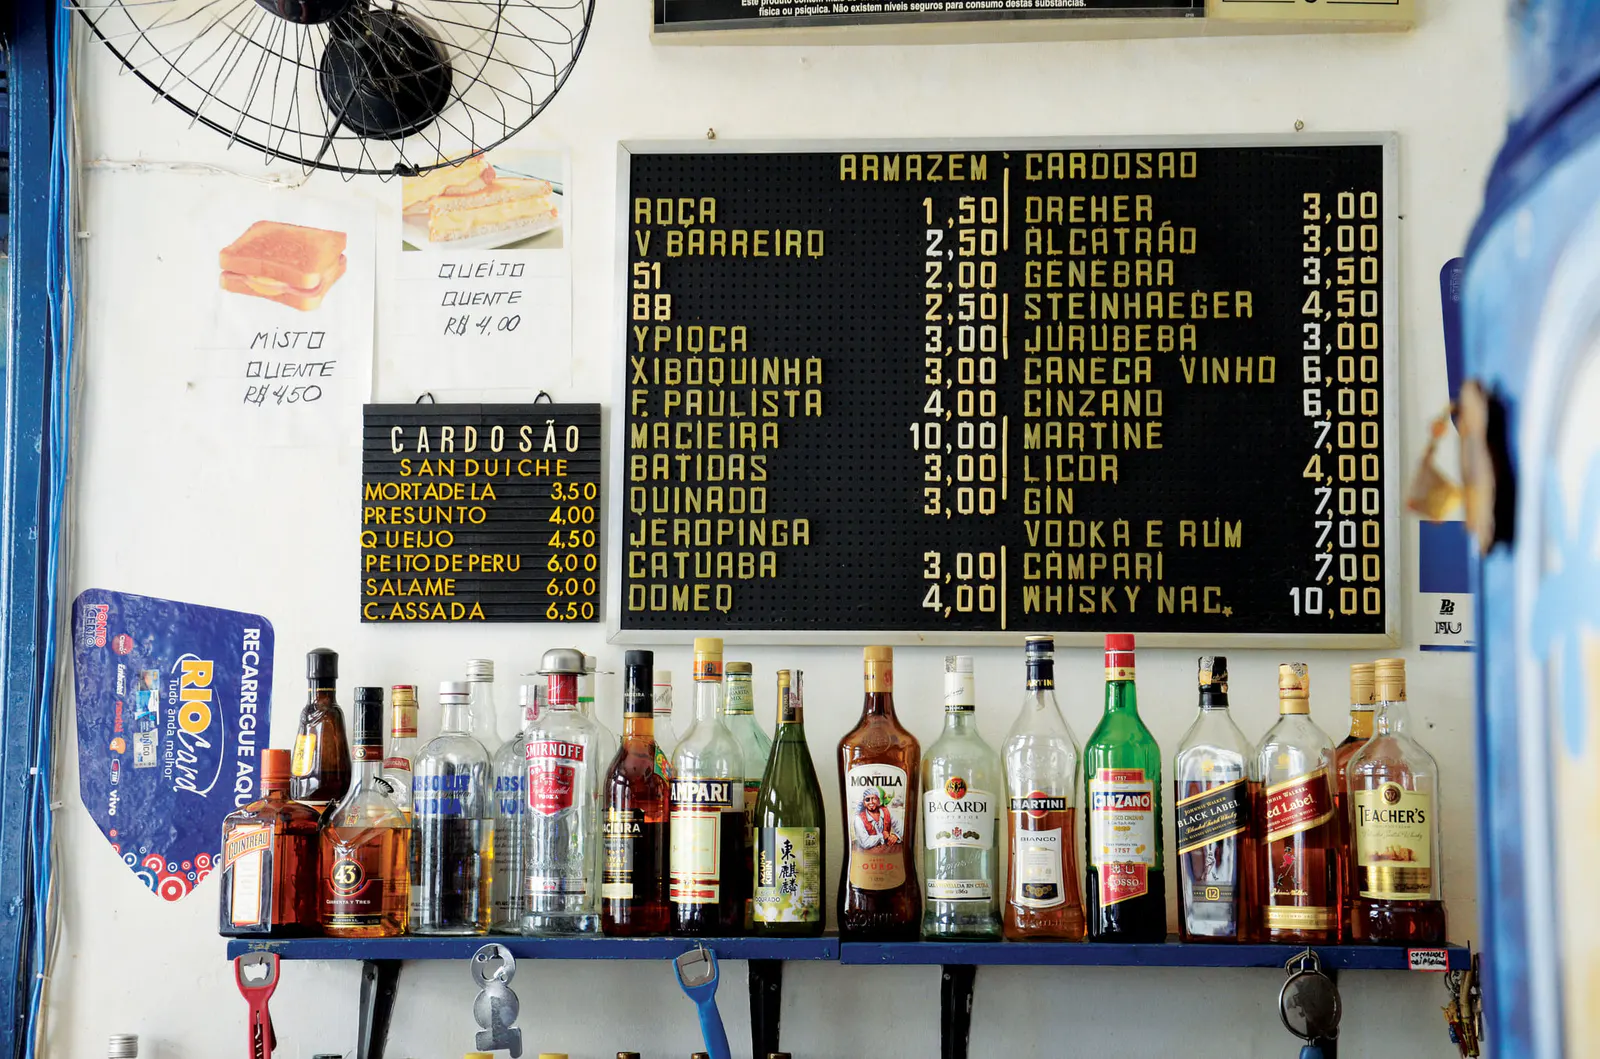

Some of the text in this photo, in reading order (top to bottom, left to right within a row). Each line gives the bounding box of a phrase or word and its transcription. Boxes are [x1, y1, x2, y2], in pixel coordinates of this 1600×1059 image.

[833, 3, 849, 13] Não
[850, 3, 882, 12] existem
[910, 2, 944, 12] seguros
[945, 1, 964, 11] para
[965, 1, 1004, 9] consumo
[841, 152, 1196, 181] ARMAZEM CARDOSAO
[923, 196, 997, 228] 1,50
[1026, 191, 1377, 225] DREHER 3,00
[635, 229, 997, 260] V BARREIRO 2,50
[1304, 224, 1377, 257] 3,00
[634, 261, 996, 292] 51 2,00
[1025, 257, 1377, 289] GENEBRA 3,50
[441, 291, 522, 306] QUENTE
[633, 293, 996, 324] 88 2,50
[1025, 290, 1377, 321] STEINHAEGER 4,50
[444, 314, 470, 336] R$
[634, 325, 996, 356] YPIOCA 3,00
[1025, 322, 1377, 353] JURUBEBA 3,00
[246, 360, 337, 379] QUENTE
[631, 356, 996, 388] XIBOQUINHA 3,00
[1025, 355, 1377, 387] CANECA VINHO 6,00
[244, 384, 270, 407] R$
[665, 388, 821, 418] PAULISTA
[924, 389, 995, 421] 4,00
[1025, 388, 1378, 420] CINZANO 6,00
[391, 420, 578, 454] CARDOSÃO
[632, 421, 995, 452] MACIEIRA 10,00
[1024, 421, 1378, 453] MARTINE 7,00
[631, 453, 996, 485] BATIDAS 3,00
[1025, 454, 1378, 486] LICOR 4,00
[365, 482, 596, 501] MORTADELA 3,50
[631, 487, 995, 518] QUINADO 3,00
[1024, 486, 1379, 519] GIN 7,00
[365, 506, 594, 525] PRESUNTO 4,00
[360, 530, 595, 549] QUEIJO 4,50
[631, 518, 809, 548] JEROPINGA
[1024, 518, 1379, 552] VODKA E RUM 7,00
[367, 554, 596, 572] PEITO DE PERU 6,00
[629, 551, 995, 583] CATUABA 3,00
[1024, 551, 1379, 584] CAMPARI 7,00
[366, 578, 595, 596] SALAME 6,00
[629, 583, 995, 617] DOMEQ 4,00
[1024, 585, 1139, 614] WHISKY
[1290, 587, 1380, 618] 10,00
[95, 604, 109, 648] PONTO
[546, 602, 593, 620] 6,50
[85, 608, 97, 647] CERTO
[164, 678, 180, 780] Tudo anda melhor
[234, 628, 261, 812] RECARREGUE AQU
[525, 743, 582, 759] SMIRNOFF
[670, 782, 729, 802] AMPARI
[850, 776, 902, 787] MONTILLA
[108, 790, 120, 816] vivo
[929, 801, 987, 813] BACARDI
[1012, 800, 1063, 809] MARTINI
[1093, 793, 1150, 809] CINZANO
[1177, 799, 1240, 828] BLACK LABEL
[1266, 793, 1314, 819] ed Label
[1358, 805, 1425, 827] TEACHER'S
[228, 832, 268, 860] COINTREAU
[334, 865, 356, 884] 43
[861, 863, 894, 871] OURO
[1207, 889, 1217, 898] 12
